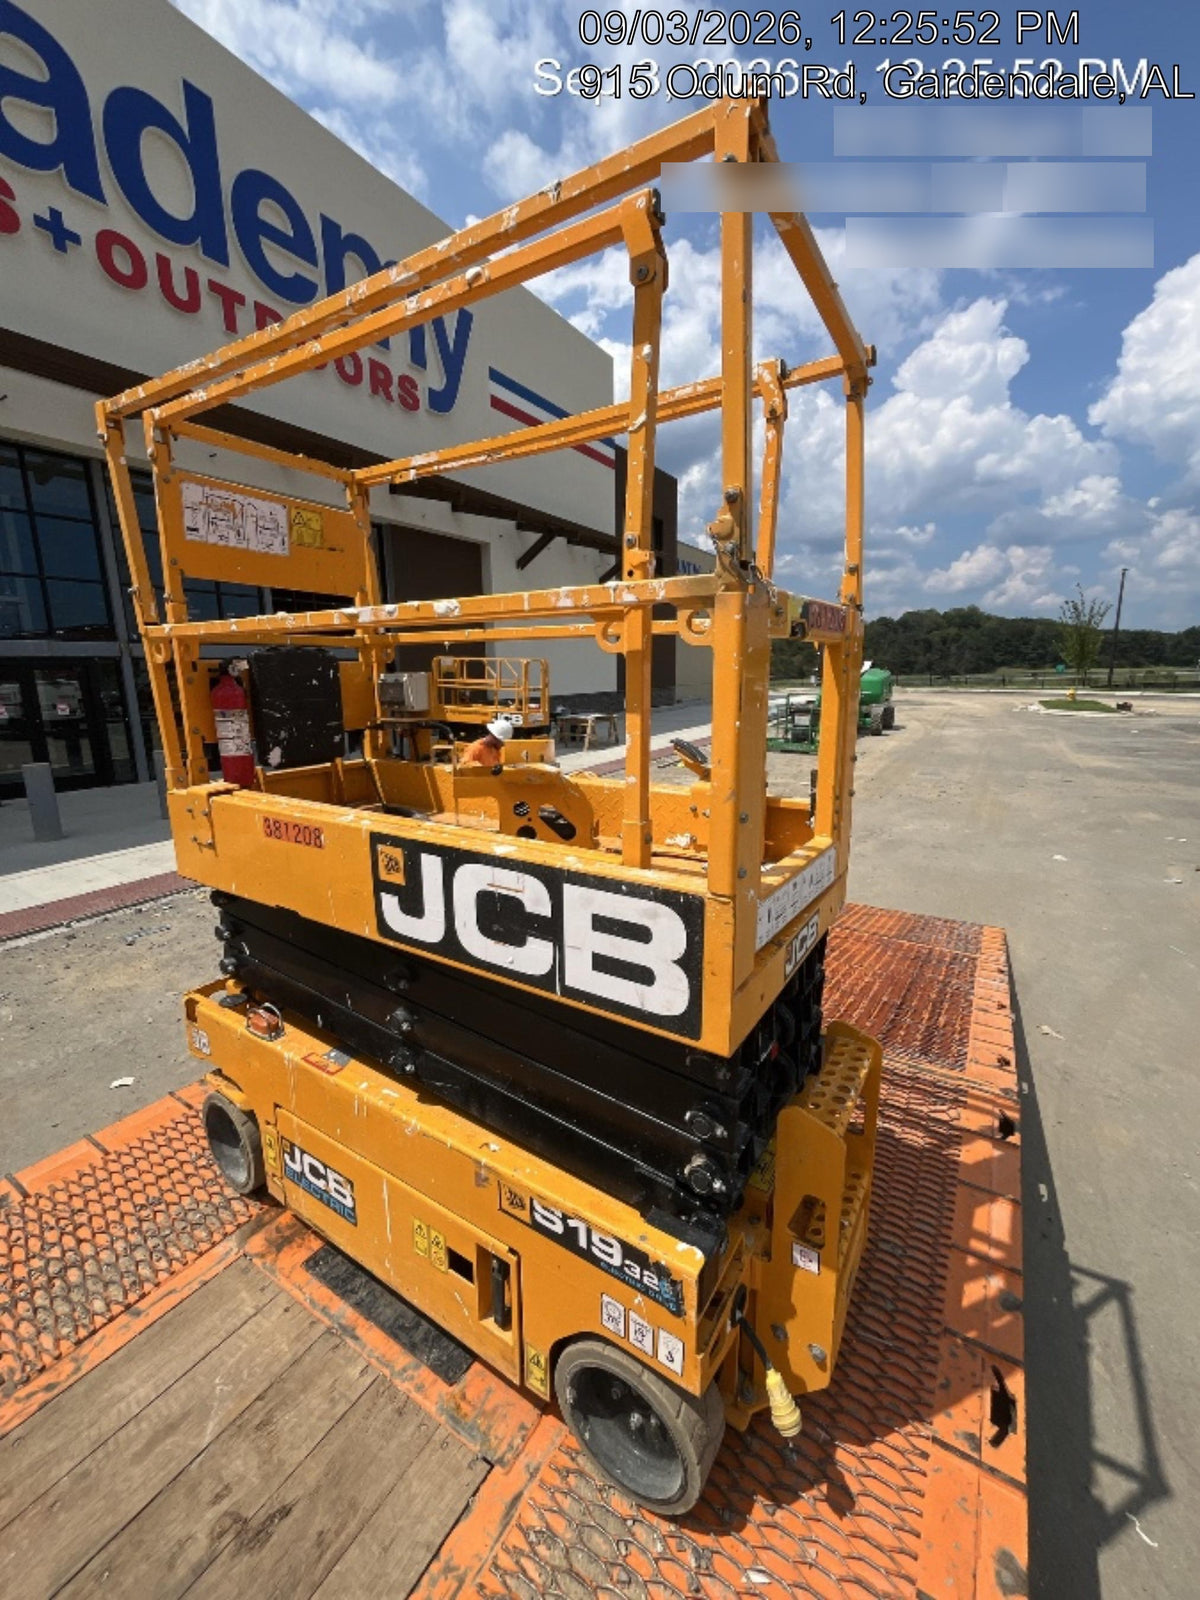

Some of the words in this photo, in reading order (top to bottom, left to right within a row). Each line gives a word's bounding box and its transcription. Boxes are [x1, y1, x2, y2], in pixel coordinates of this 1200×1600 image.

[96, 229, 421, 412] OUTORS
[263, 817, 322, 849] 381208
[380, 853, 691, 1016] JCB
[785, 913, 819, 977] JCB
[284, 1146, 355, 1208] JCB
[285, 1165, 357, 1224] ELECTRIC
